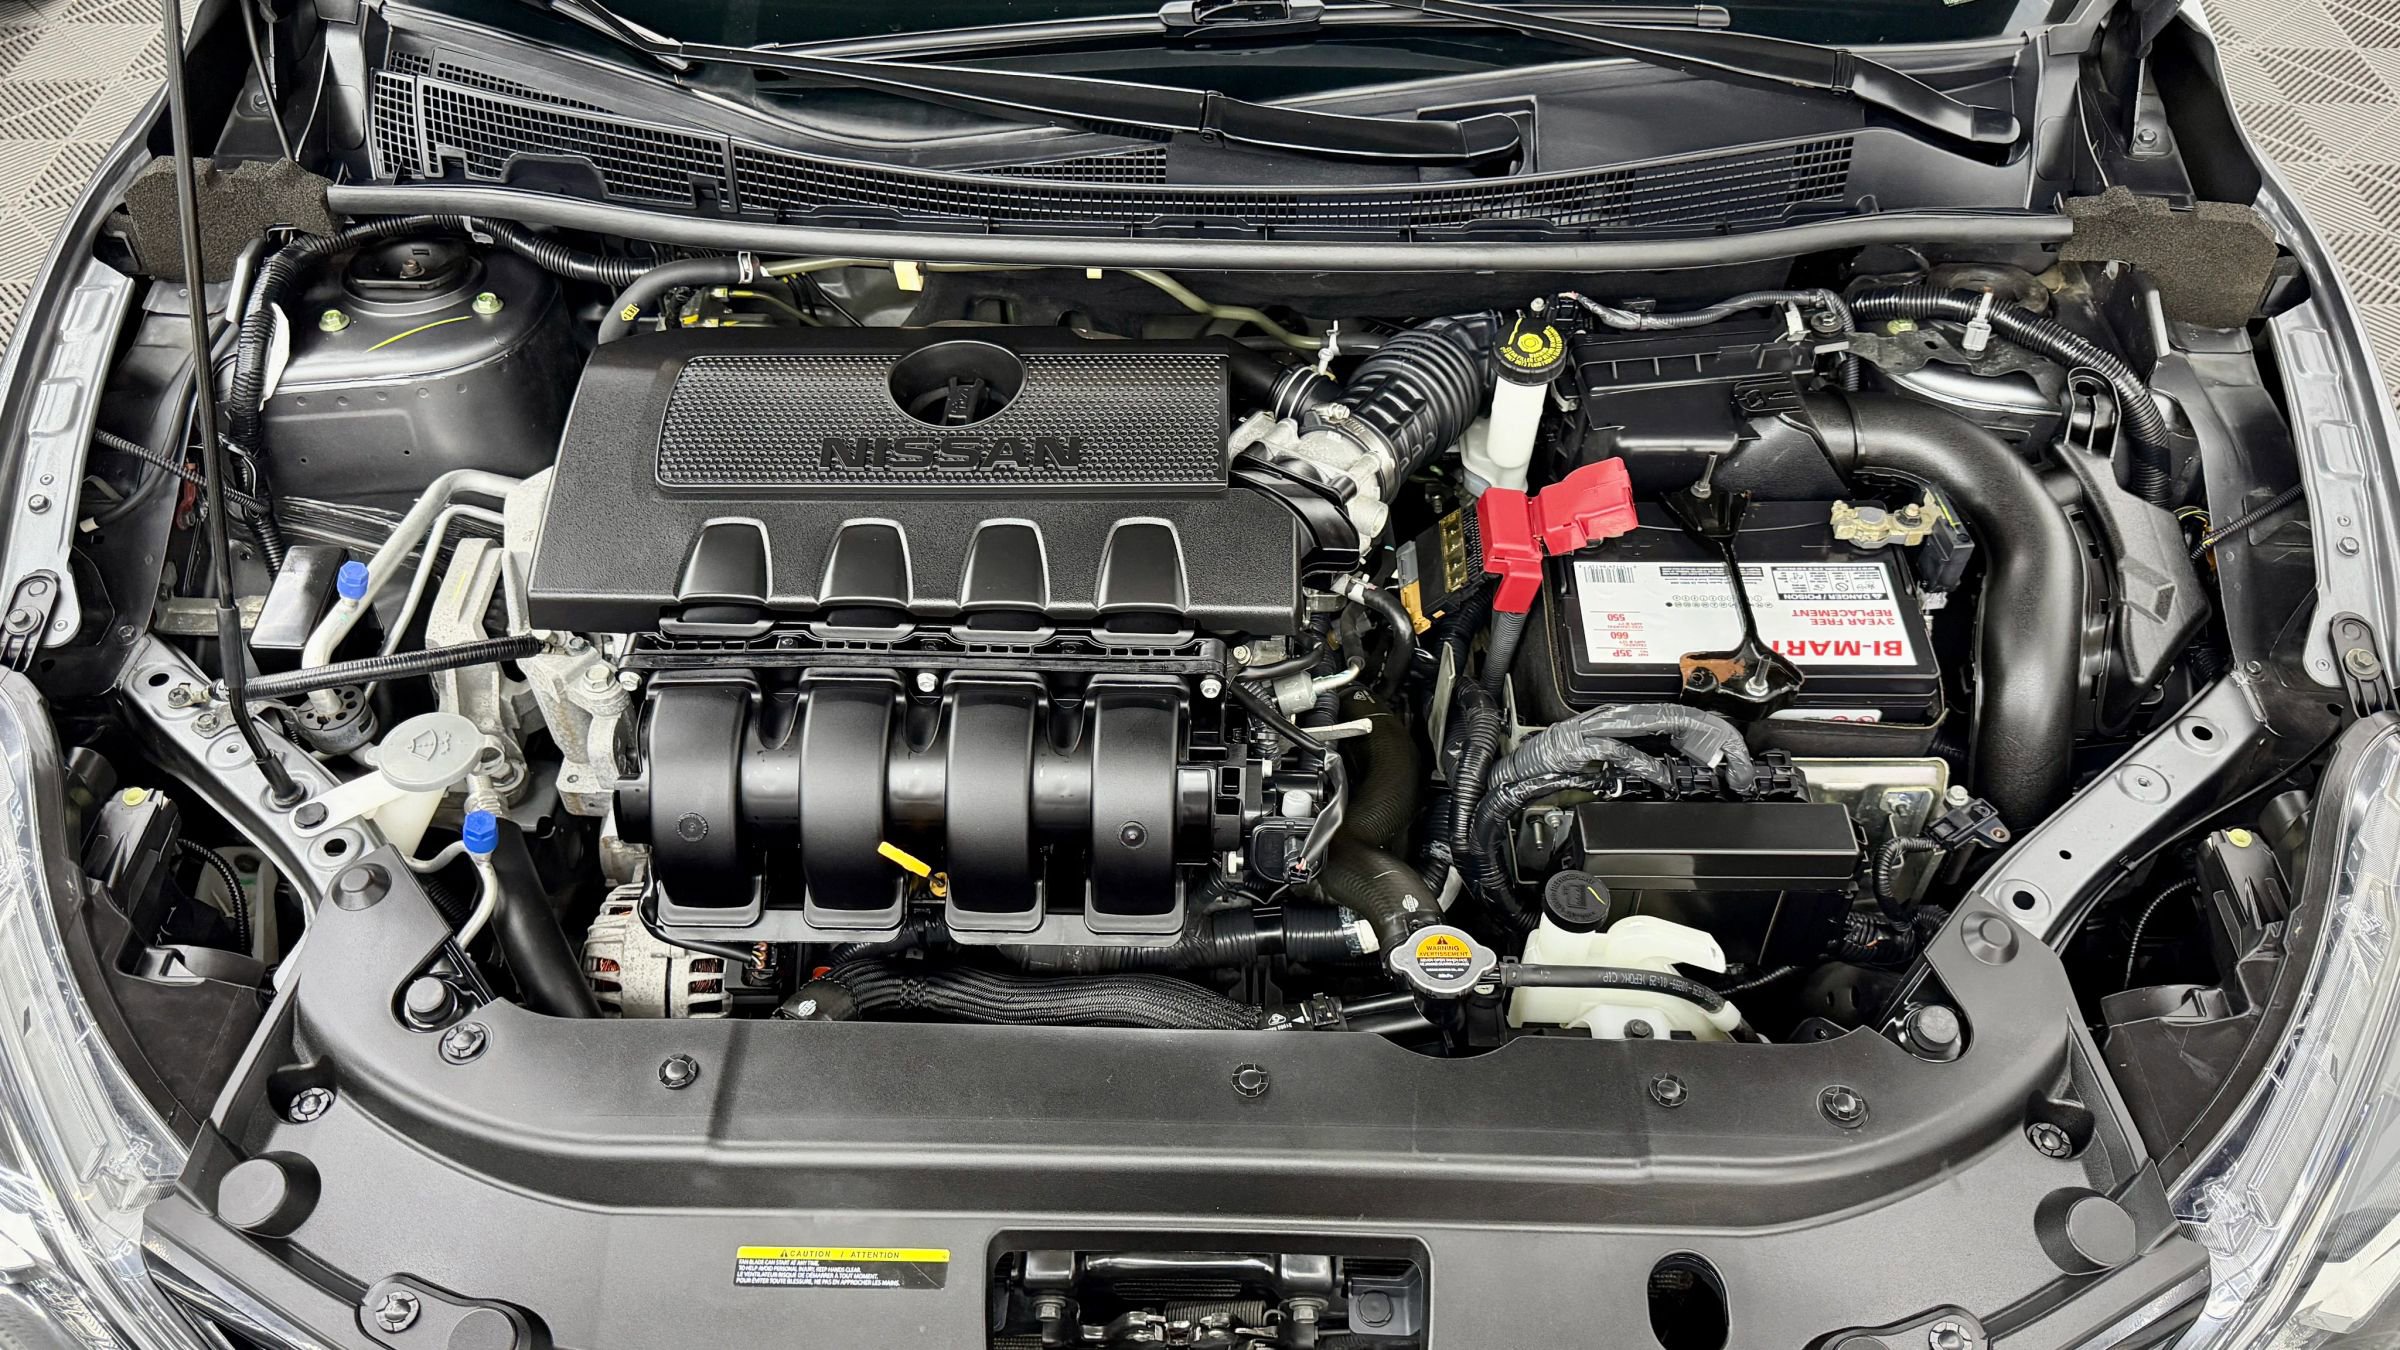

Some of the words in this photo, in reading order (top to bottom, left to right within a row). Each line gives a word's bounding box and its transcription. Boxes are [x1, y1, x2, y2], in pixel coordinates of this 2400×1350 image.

[818, 436, 1081, 471] NISSAN
[1607, 613, 1625, 621] 550
[1792, 609, 1892, 617] REPLACEMENT
[1809, 618, 1844, 626] FREE
[1610, 631, 1628, 639] 660
[1771, 640, 1903, 657] BI-MART
[1612, 649, 1632, 657] 35P
[790, 1250, 831, 1258] CAUTION
[850, 1251, 900, 1259] ATTENTION
